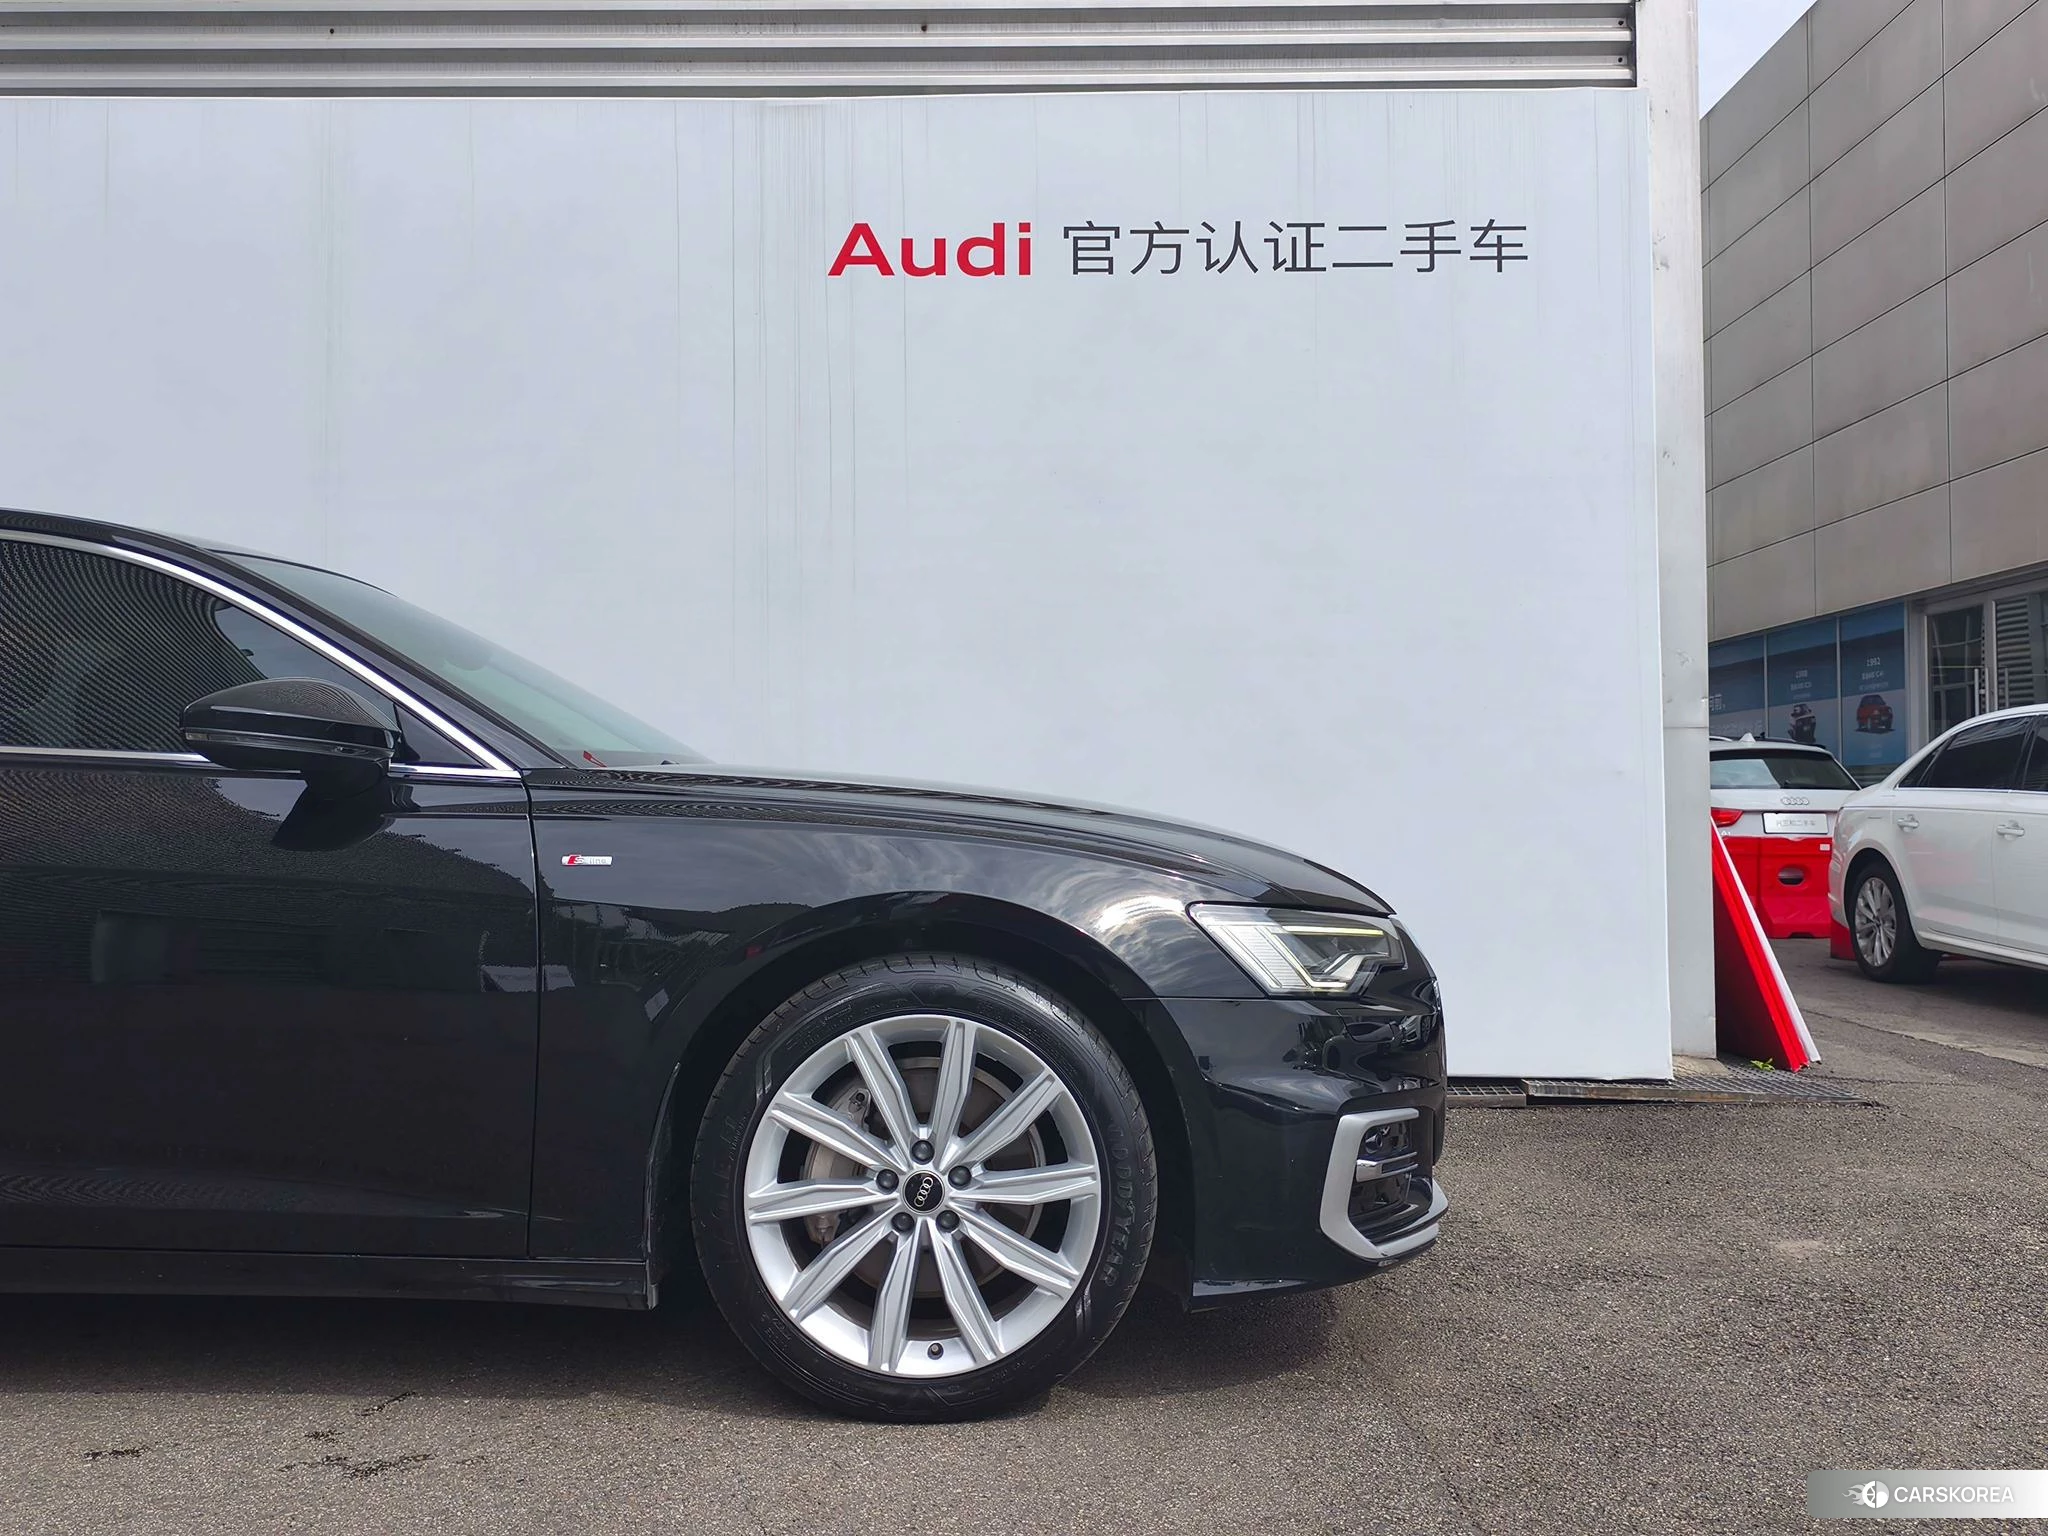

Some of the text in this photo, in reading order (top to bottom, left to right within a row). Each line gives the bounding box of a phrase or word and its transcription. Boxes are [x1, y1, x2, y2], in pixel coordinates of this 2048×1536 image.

[828, 222, 1032, 277] Audi
[1064, 219, 1529, 275] 官方认证二手车
